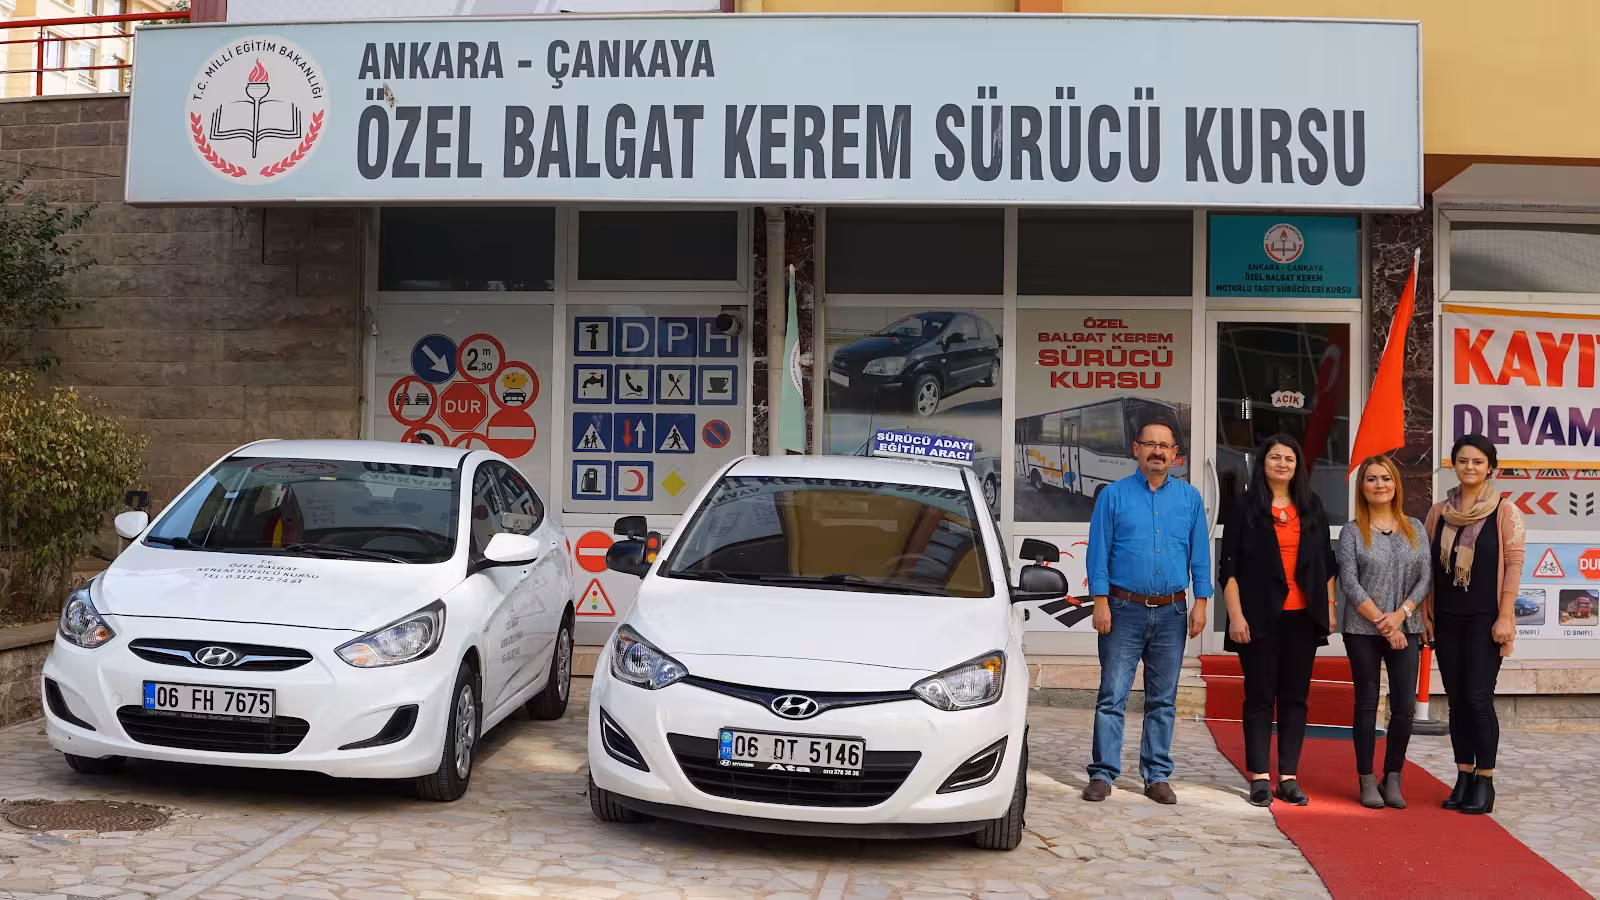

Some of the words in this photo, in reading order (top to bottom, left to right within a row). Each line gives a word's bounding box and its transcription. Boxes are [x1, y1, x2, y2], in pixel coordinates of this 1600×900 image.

[193, 81, 209, 101] T.C.
[204, 47, 234, 78] MİLLİ
[235, 40, 277, 56] EĞİTİM
[279, 45, 324, 99] BAKANLIĞI
[358, 41, 503, 80] ANKARA
[547, 39, 715, 89] ÇANKAYA
[356, 88, 483, 181] ÖZEL
[504, 103, 704, 180] BALGAT
[724, 104, 912, 181] KEREM
[934, 86, 1161, 183] SÜRÜCÜ
[1186, 106, 1366, 187] KURSU
[1245, 272, 1264, 281] ÖZEL
[1266, 274, 1294, 282] BALGAT
[1296, 274, 1323, 282] KEREM
[1287, 264, 1324, 273] ÇANKAYA
[1216, 285, 1252, 293] MOTORLU
[1276, 283, 1324, 293] SÜRÜCÜLERİ
[1326, 286, 1352, 294] KURSU
[1084, 316, 1128, 329] ÖZEL
[622, 322, 650, 353] D
[667, 322, 689, 353] P
[705, 322, 732, 353] H
[1038, 332, 1106, 343] BALGAT
[1111, 333, 1173, 343] KEREM
[1038, 345, 1173, 367] SÜRÜCÜ
[1454, 327, 1600, 388] KAYI
[1050, 371, 1161, 388] KURSU
[444, 399, 481, 415] DUR
[1454, 404, 1600, 447] DEVAM
[876, 431, 931, 446] SÜRÜCÜ
[934, 438, 974, 451] ADAYI
[879, 442, 926, 455] EĞİTİM
[929, 449, 970, 460] ARACI
[236, 568, 281, 576] SÜRÜCÜ
[1580, 558, 1600, 571] DU
[157, 686, 179, 708] 06
[192, 689, 214, 711] FH
[224, 691, 270, 714] 7675
[722, 746, 732, 755] TR
[735, 735, 759, 758] 06
[773, 738, 798, 761] DT
[809, 741, 860, 766] 5146
[767, 763, 811, 773] Ata
